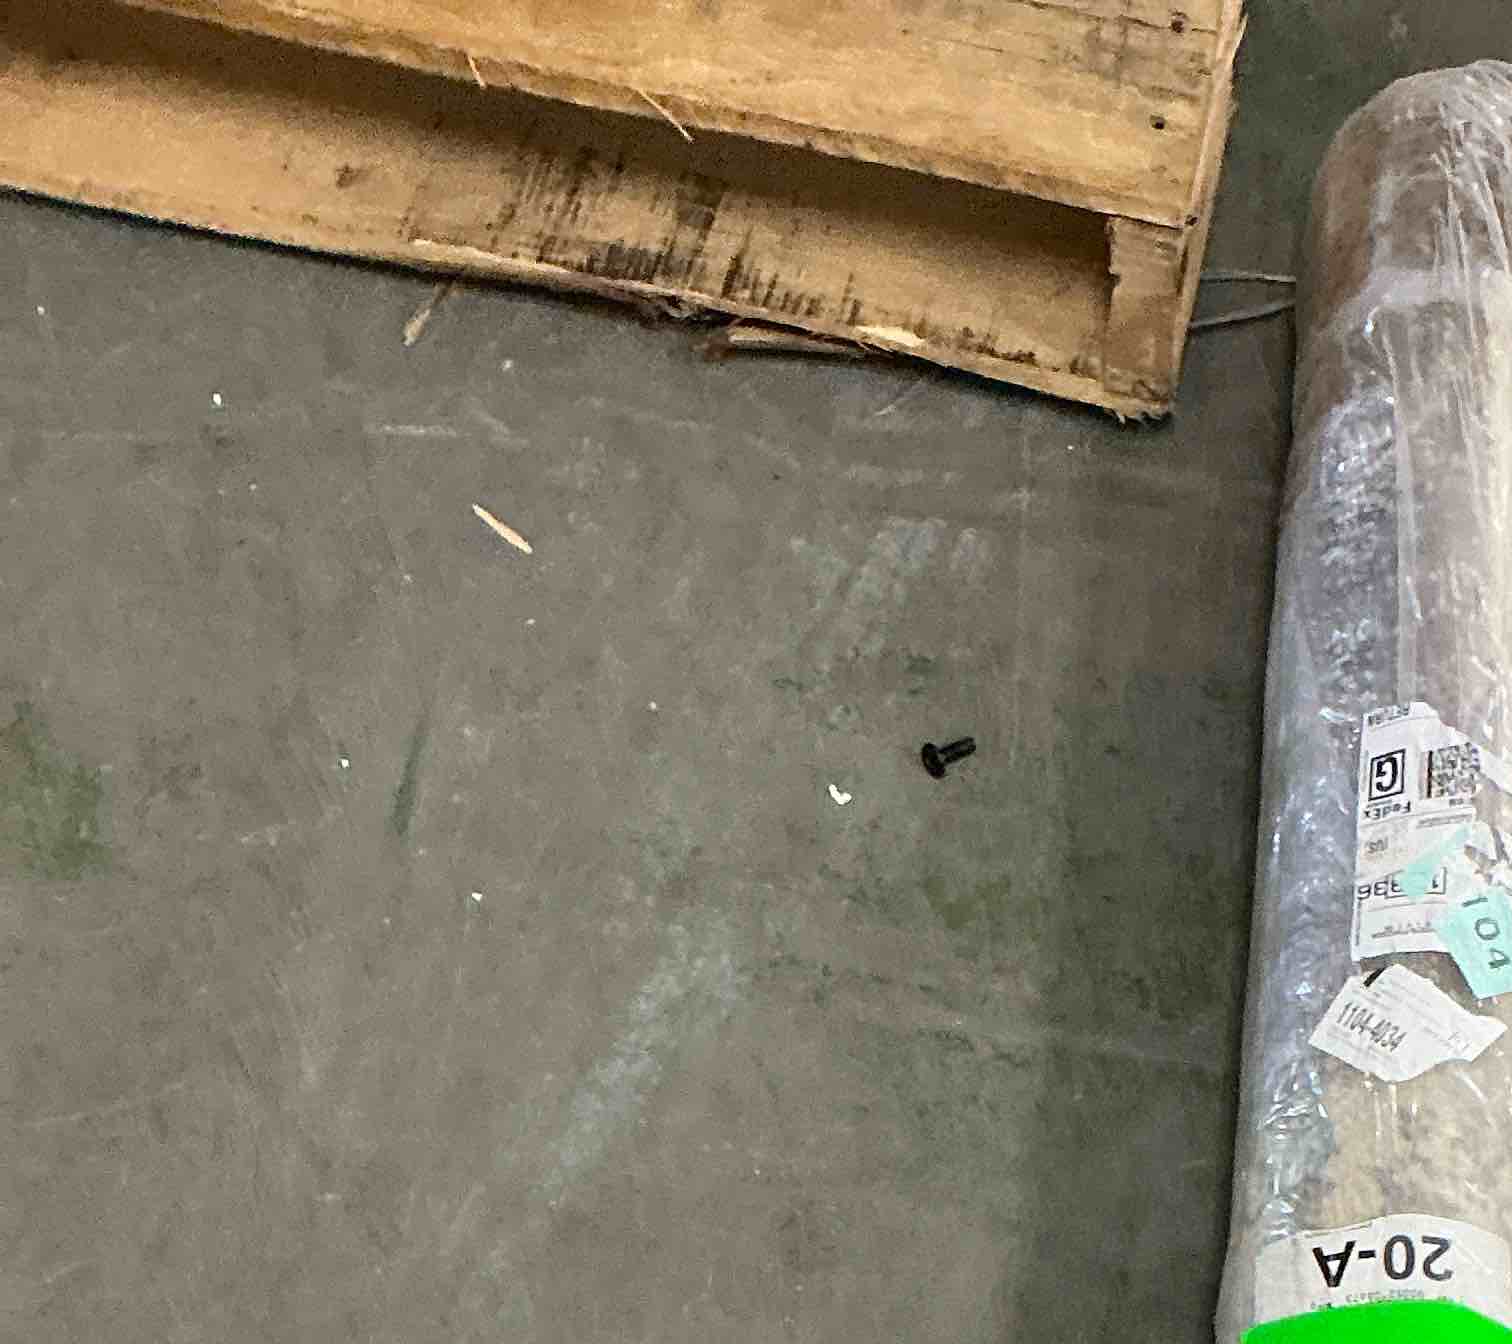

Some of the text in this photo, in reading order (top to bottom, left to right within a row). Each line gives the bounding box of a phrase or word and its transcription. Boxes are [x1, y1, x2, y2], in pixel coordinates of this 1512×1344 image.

[1374, 755, 1399, 793] G
[1363, 801, 1411, 821] FedEx
[1311, 1234, 1454, 1288] 20-A
